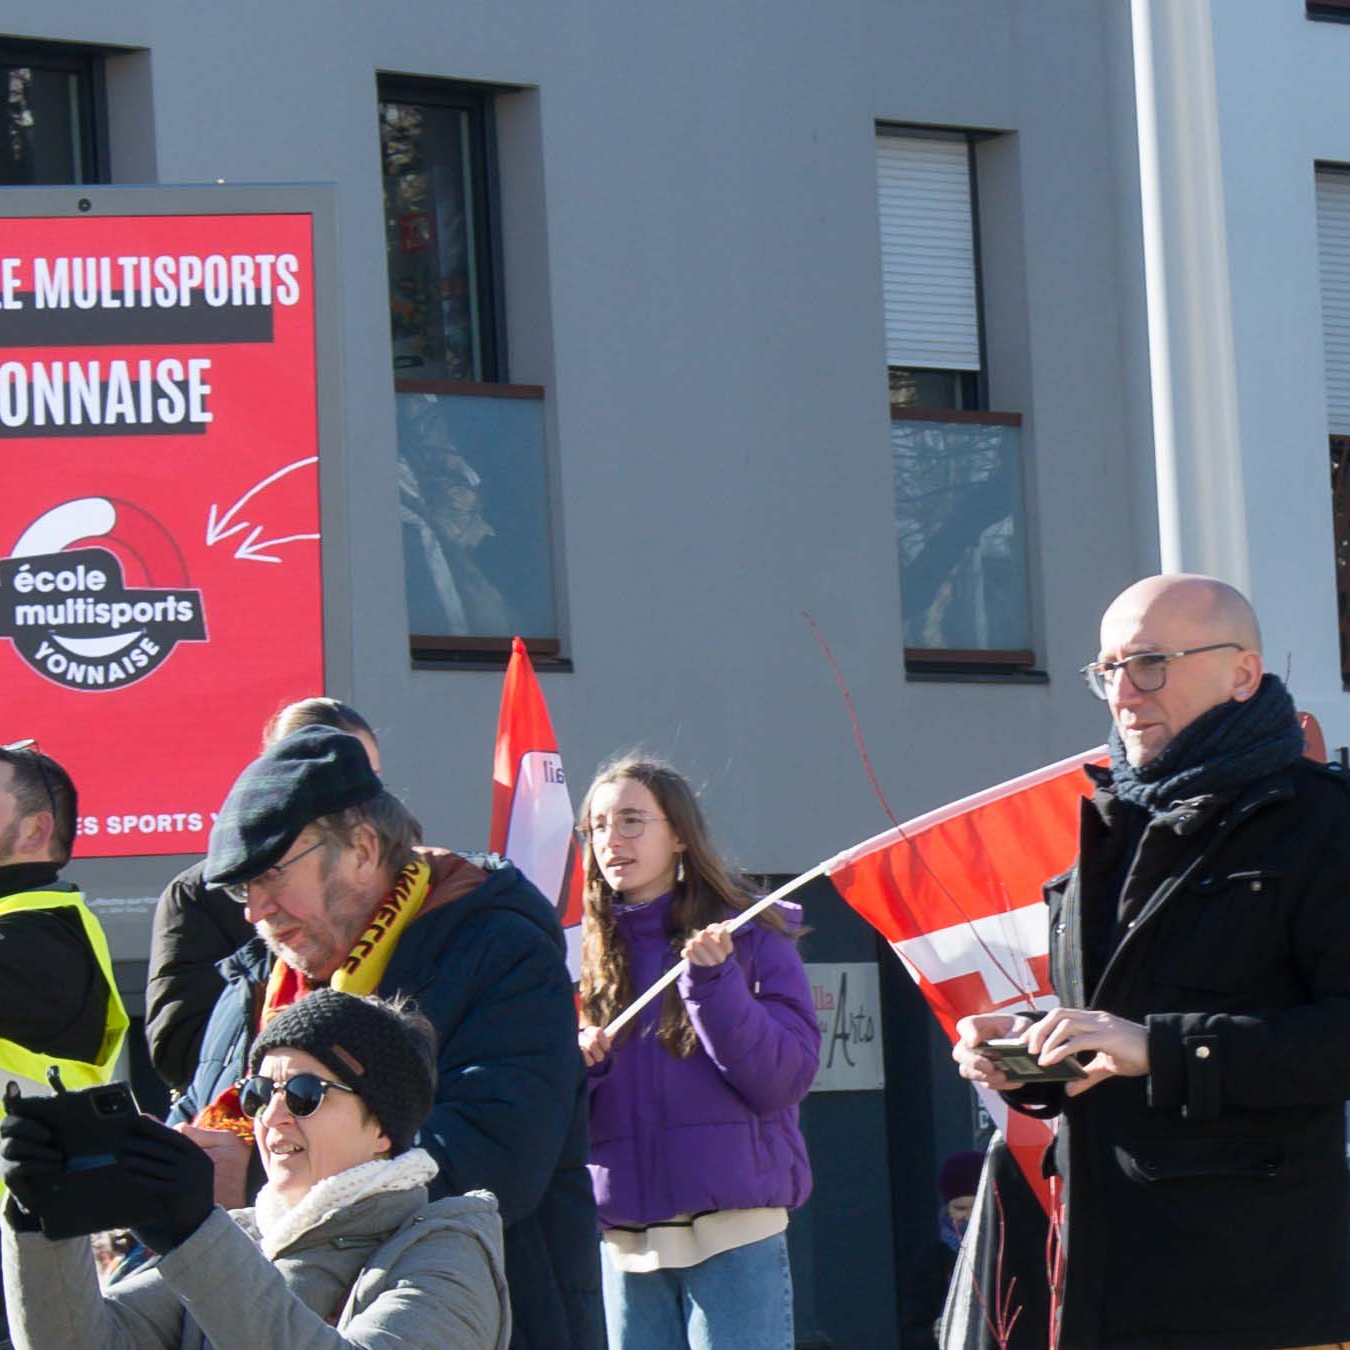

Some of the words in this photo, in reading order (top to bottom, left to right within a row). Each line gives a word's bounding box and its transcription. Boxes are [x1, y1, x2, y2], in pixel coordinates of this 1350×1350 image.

[34, 253, 300, 311] MULTISPORTS
[13, 563, 107, 594] école
[14, 596, 194, 629] multisports
[34, 637, 161, 685] YONNAISE
[106, 812, 204, 835] SPORTS
